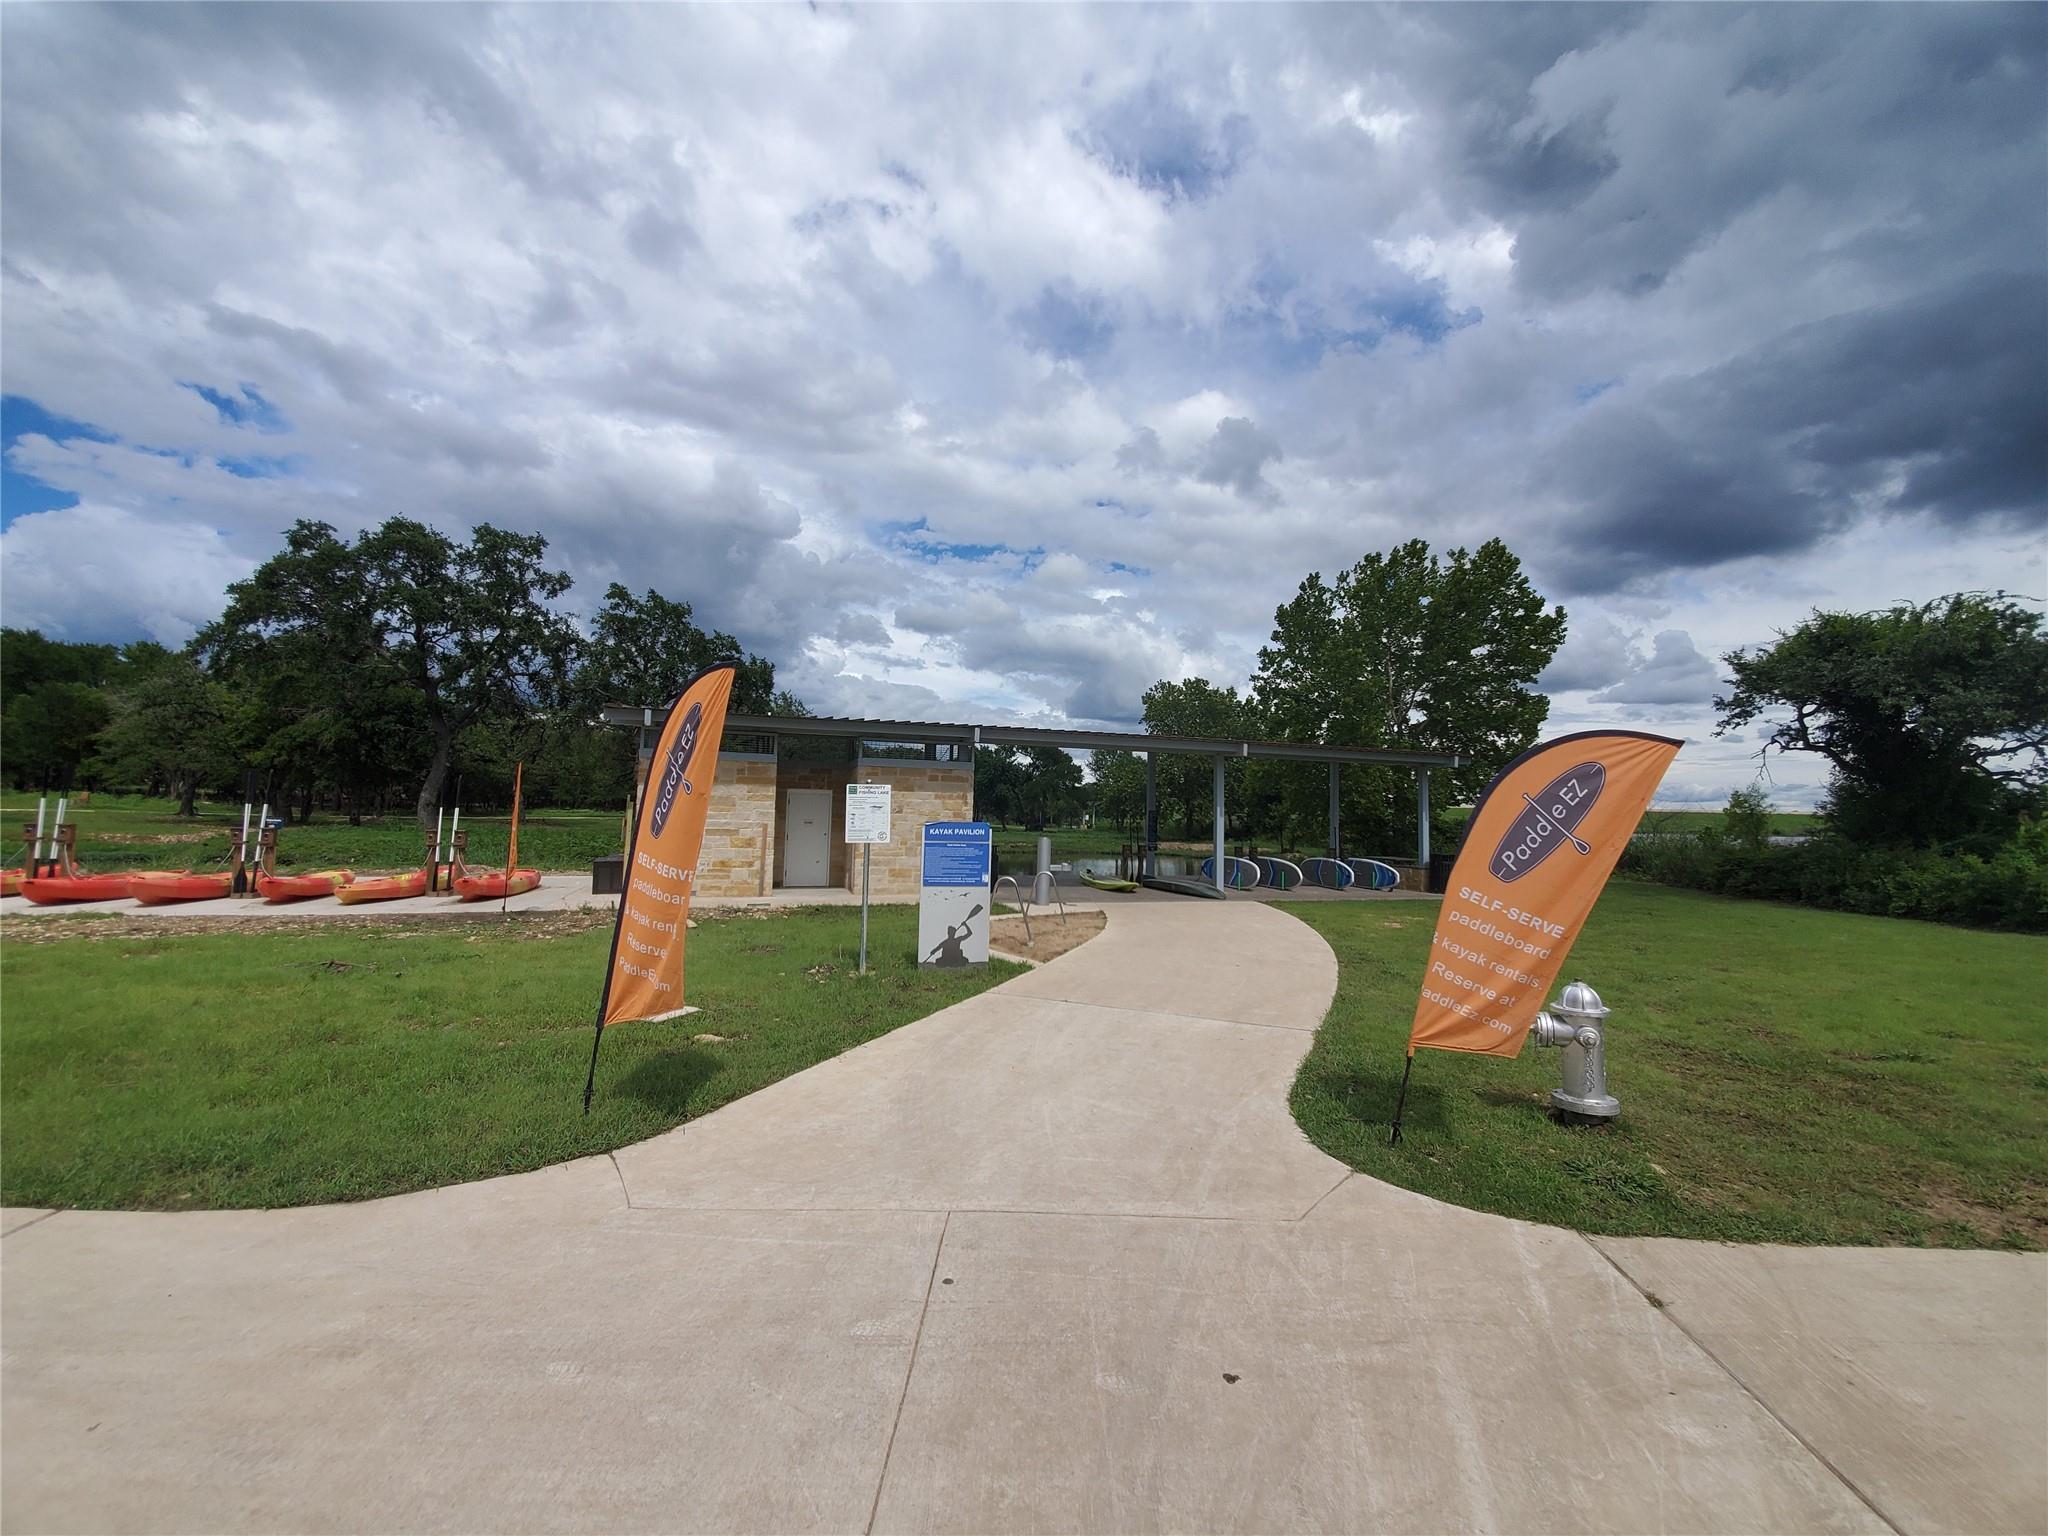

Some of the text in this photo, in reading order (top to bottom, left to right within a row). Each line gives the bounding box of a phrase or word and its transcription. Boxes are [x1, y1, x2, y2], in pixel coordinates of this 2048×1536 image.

[954, 828, 985, 836] PAVILION
[633, 877, 686, 906] paddleboar
[1458, 886, 1566, 939] SELF-SERVE
[1448, 910, 1552, 960] paddleboard
[1431, 961, 1518, 1008] Reserve at
[1441, 936, 1487, 967] kayak
[1488, 960, 1543, 990] rentals.
[1421, 984, 1512, 1035] addleEz.com
